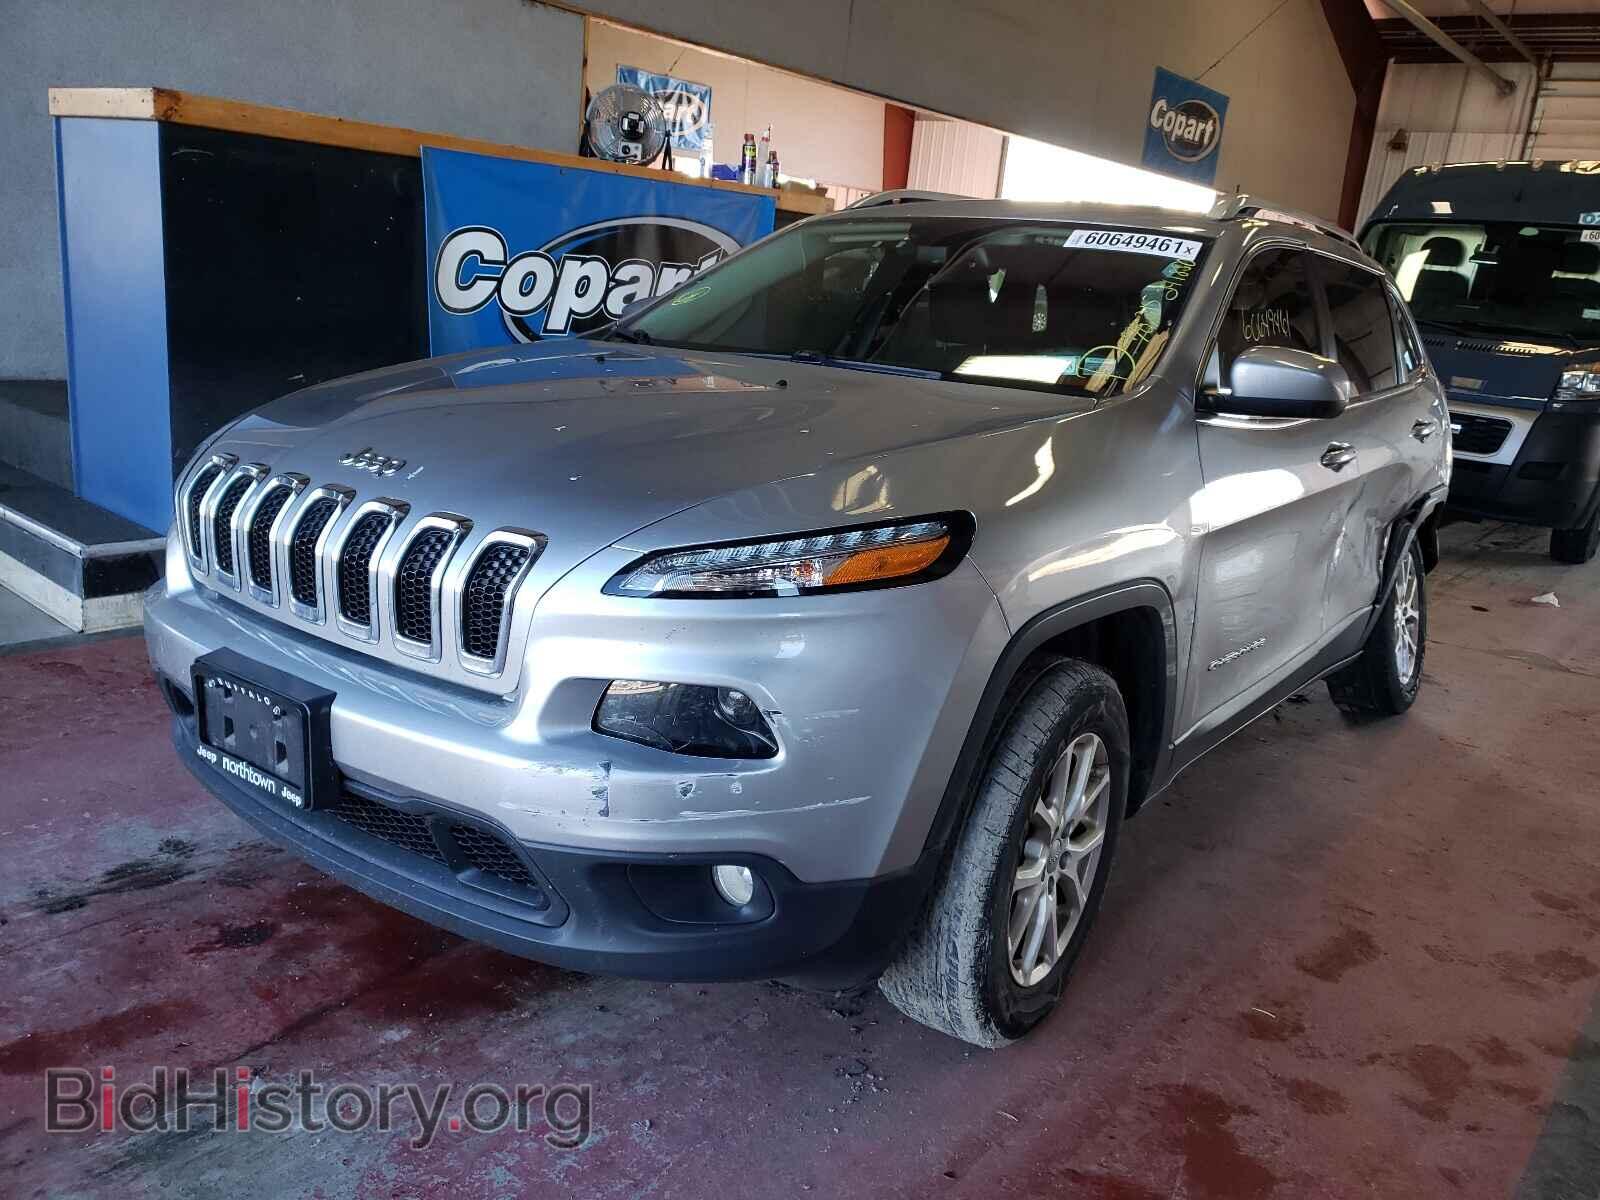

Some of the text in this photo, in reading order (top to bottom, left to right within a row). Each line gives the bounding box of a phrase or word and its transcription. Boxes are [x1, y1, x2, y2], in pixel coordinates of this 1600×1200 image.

[1150, 99, 1215, 145] Copart
[1084, 231, 1184, 254] 60649461
[196, 745, 302, 806] Jeep northtown Jeep
